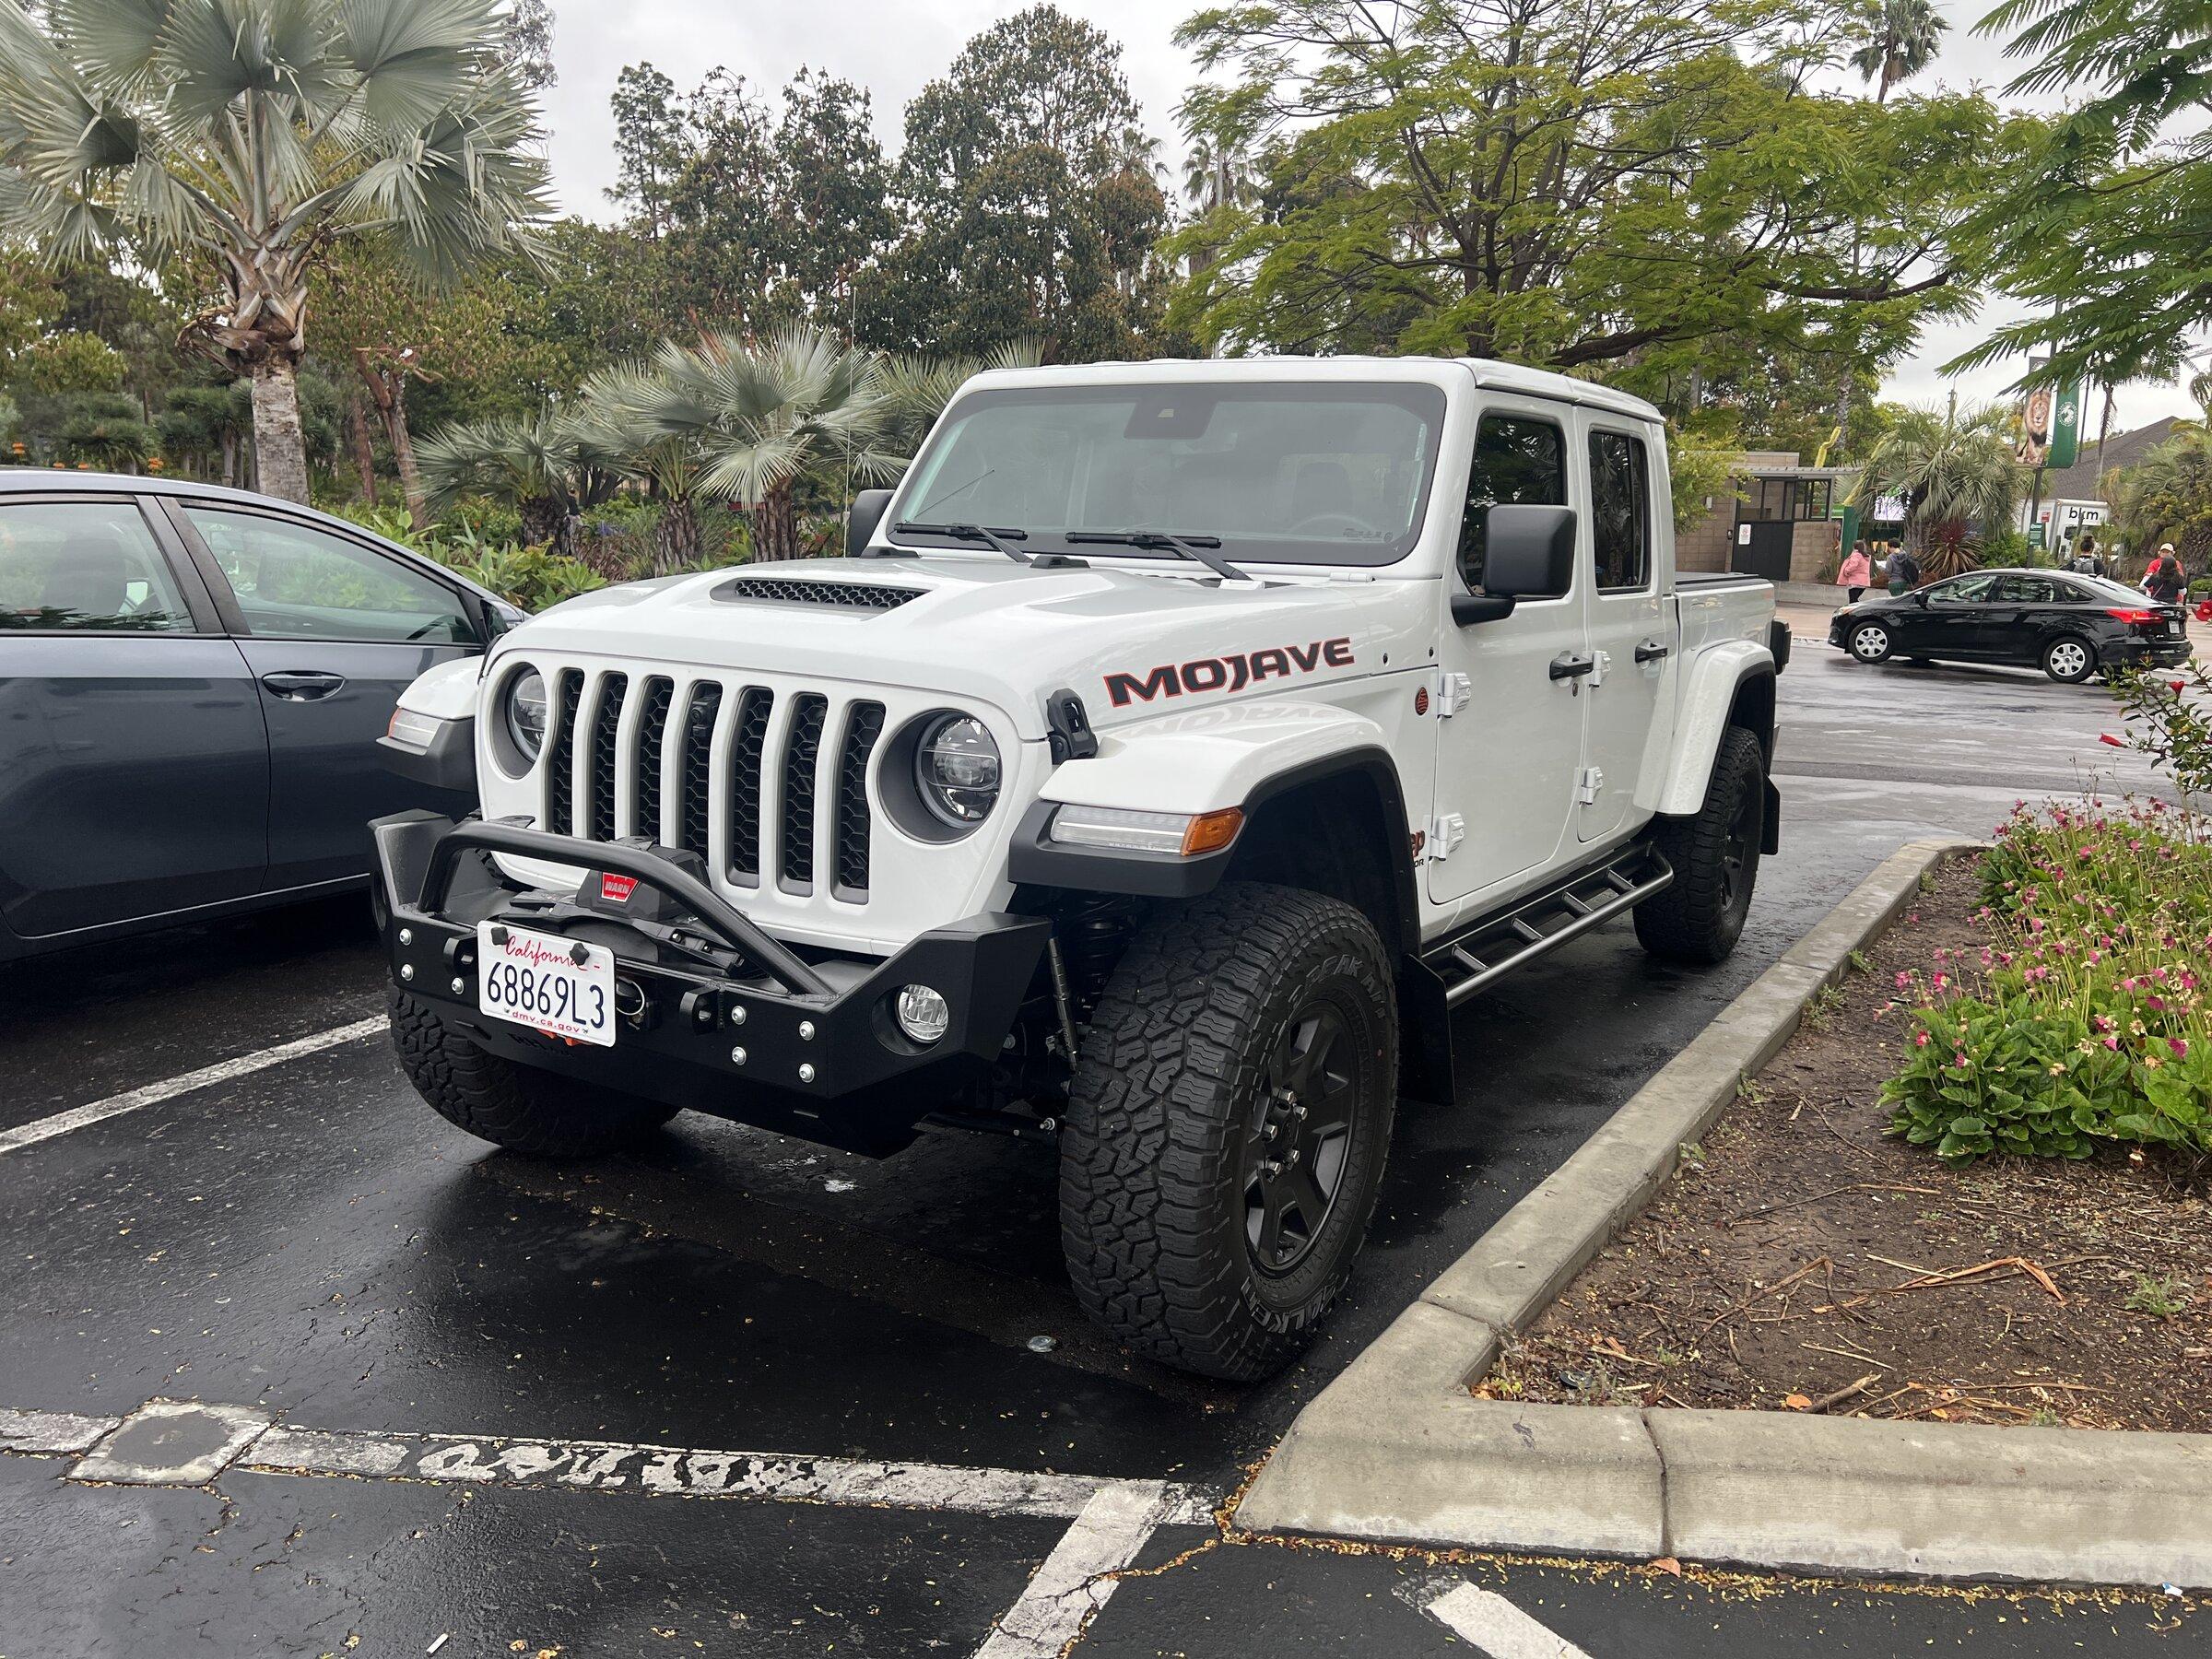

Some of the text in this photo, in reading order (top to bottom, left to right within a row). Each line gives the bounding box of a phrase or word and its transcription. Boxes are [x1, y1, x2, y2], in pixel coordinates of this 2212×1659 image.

[1103, 637, 1355, 708] MOJAVE
[605, 881, 630, 895] WARN
[487, 961, 605, 1030] 68869L3
[512, 1010, 580, 1033] dmv.ca.gov
